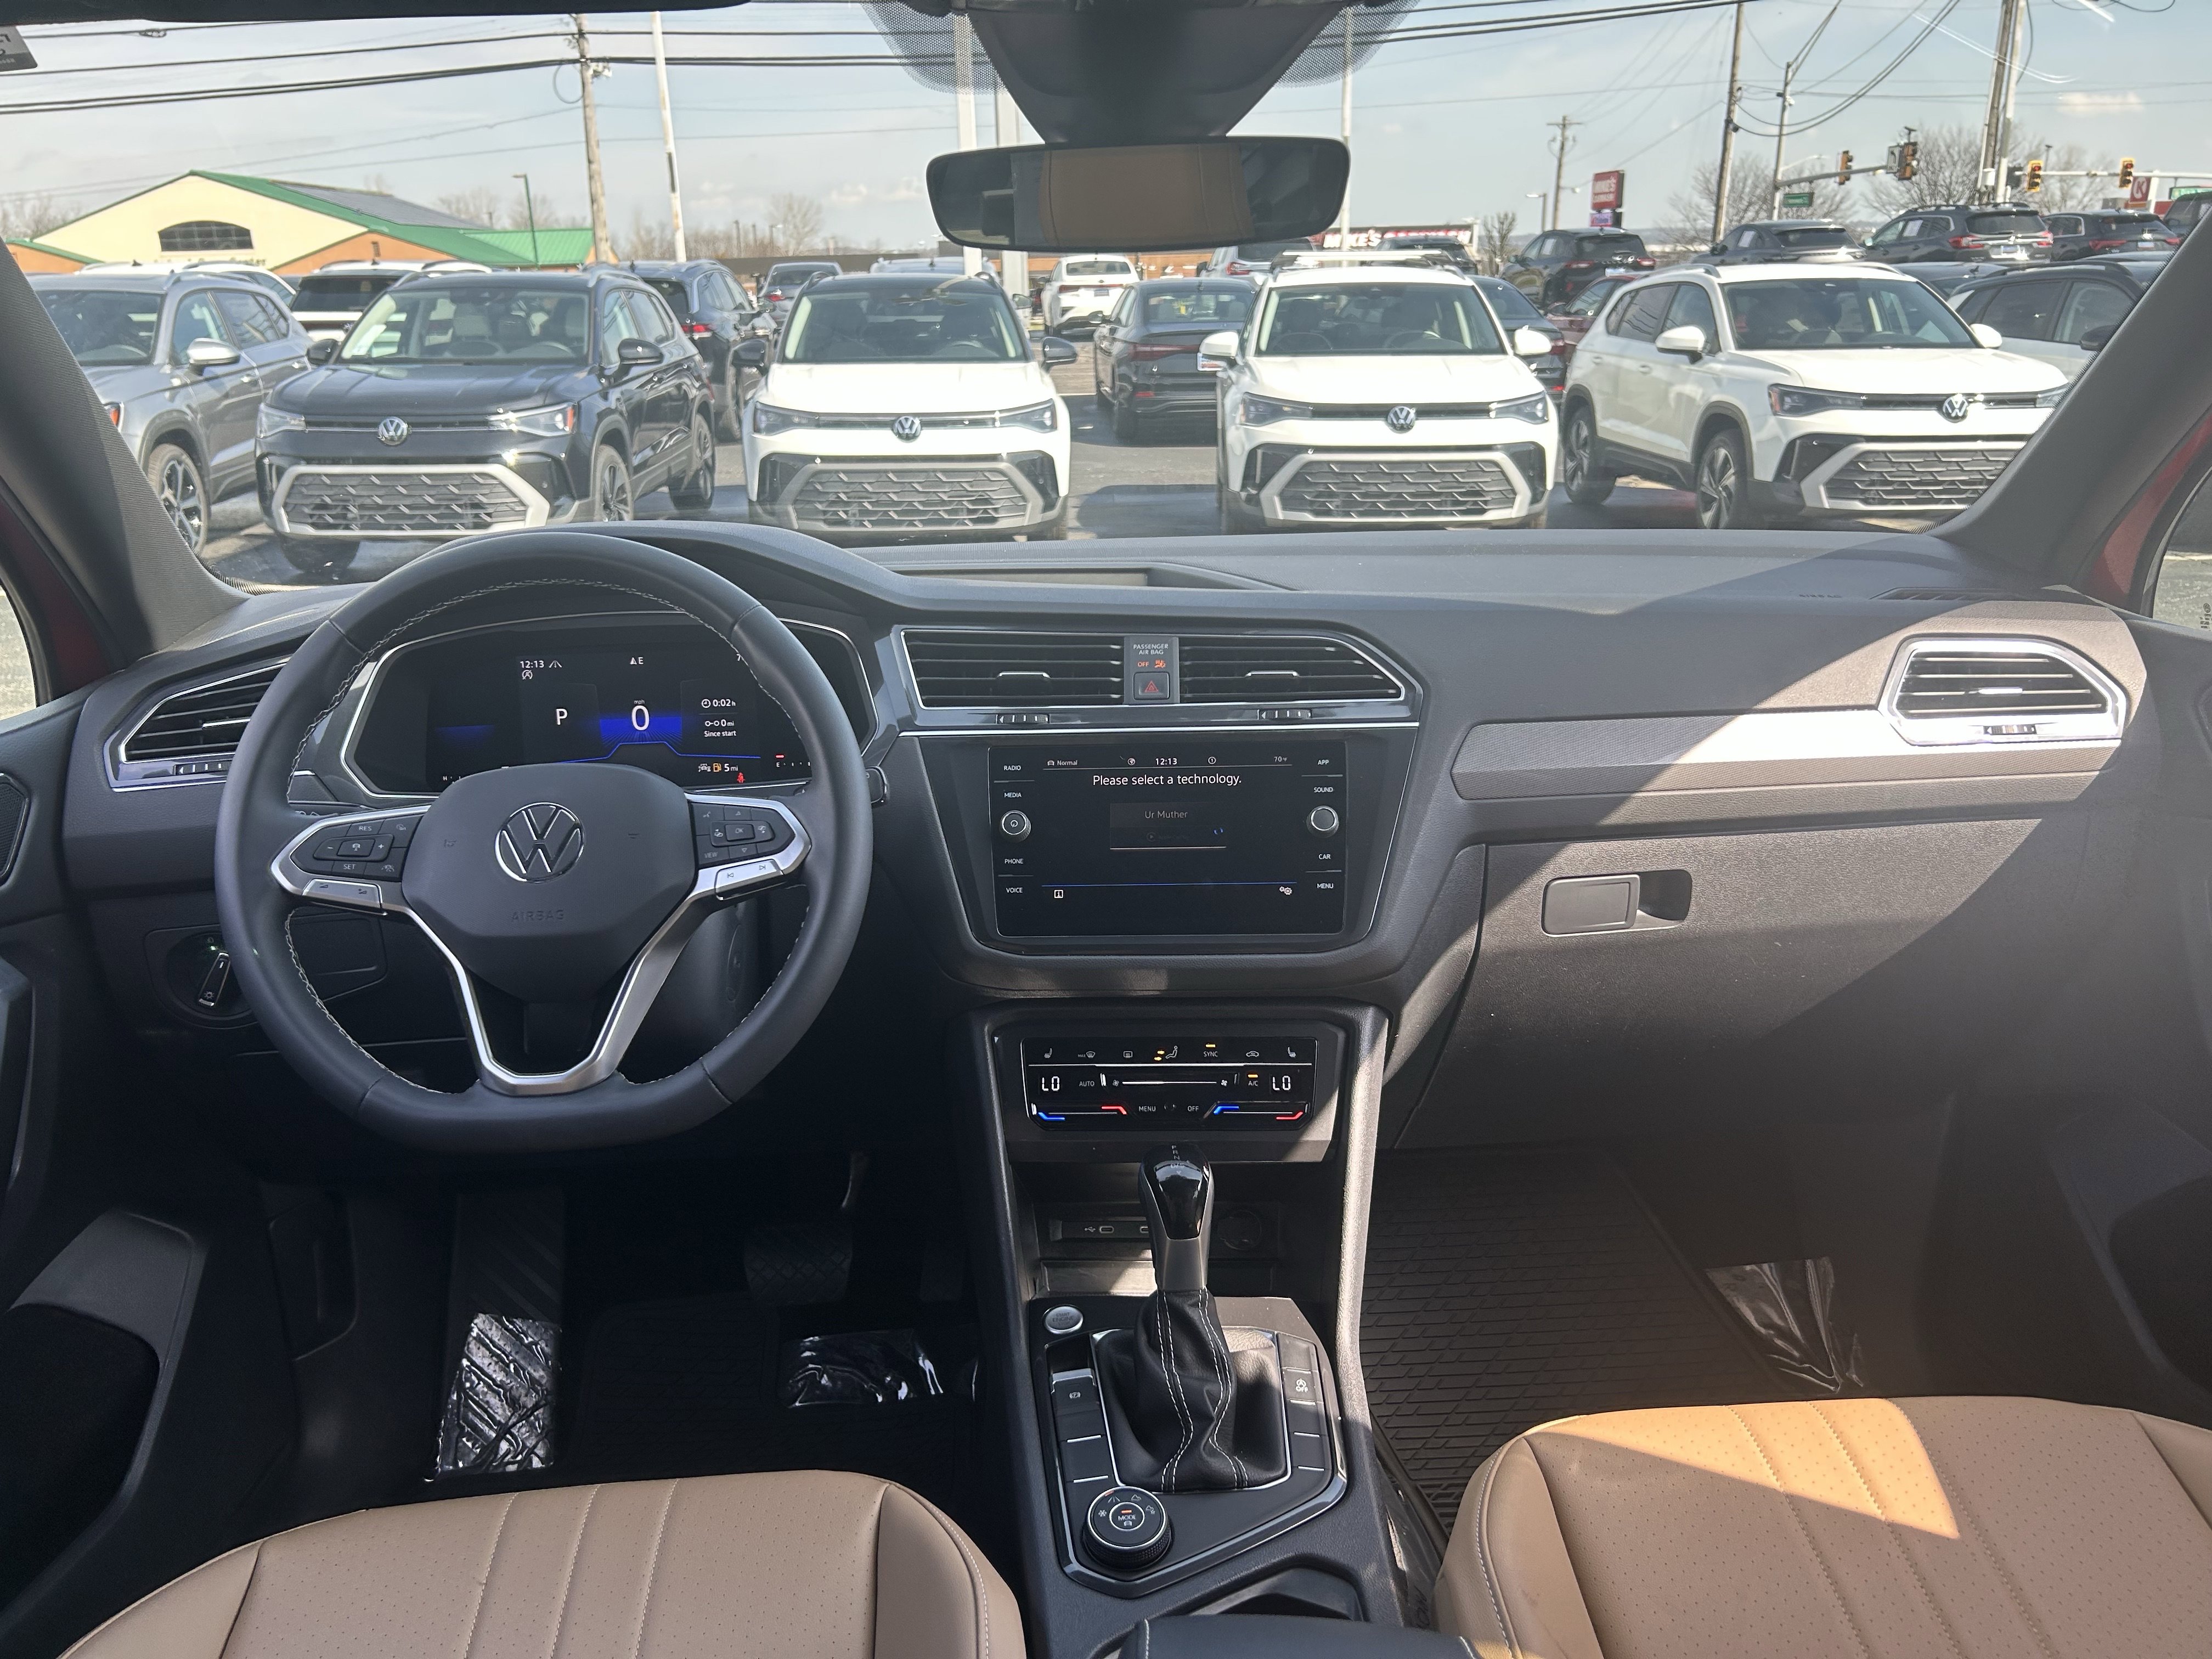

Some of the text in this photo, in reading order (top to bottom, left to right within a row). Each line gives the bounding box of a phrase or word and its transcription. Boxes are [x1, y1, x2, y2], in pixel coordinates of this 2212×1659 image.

[1323, 229, 1381, 248] MKE'S
[556, 708, 568, 725] P
[631, 705, 650, 731] 0
[1155, 758, 1177, 766] 12:13
[1093, 775, 1128, 786] Please
[1131, 775, 1164, 785] select
[1177, 773, 1242, 786] technology.
[1144, 810, 1188, 819] Ur Muther
[511, 909, 564, 922] AIRBAG
